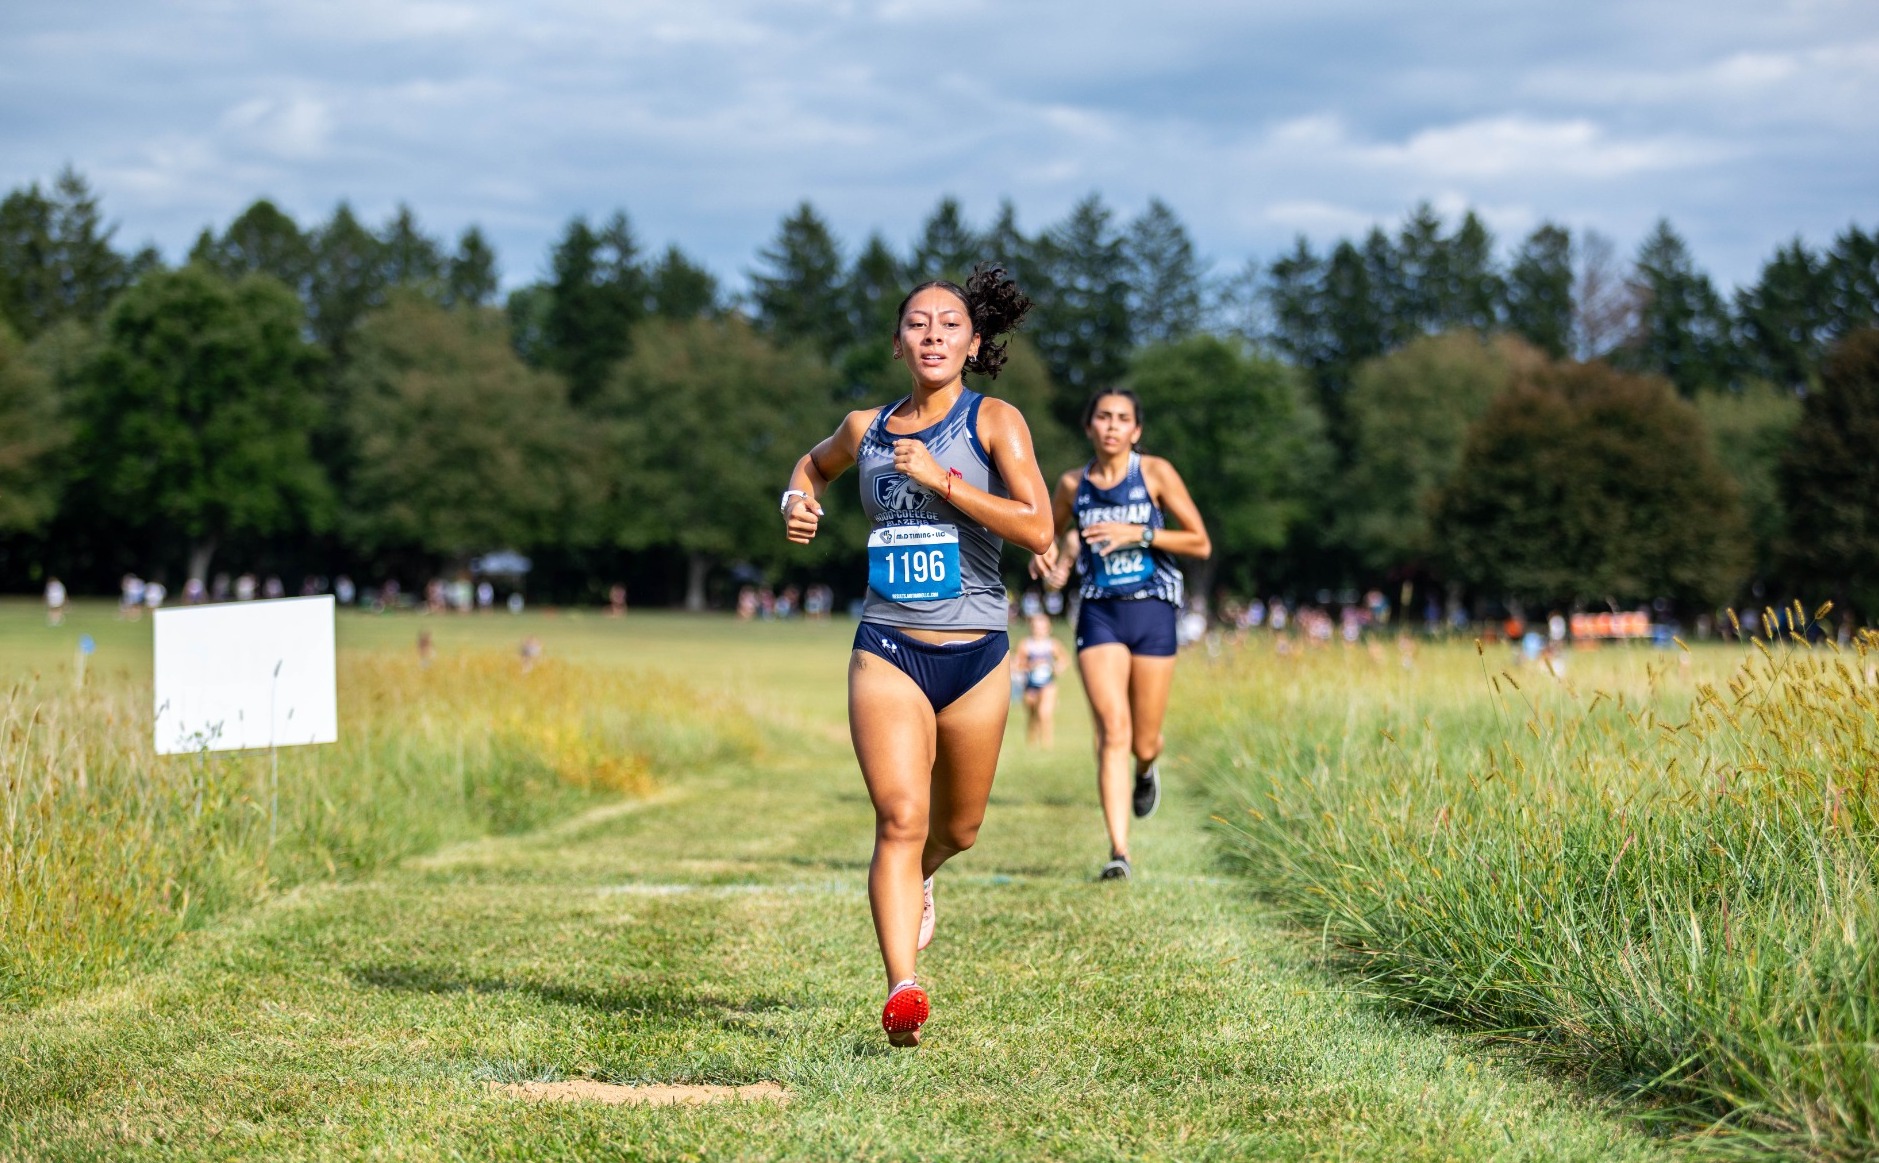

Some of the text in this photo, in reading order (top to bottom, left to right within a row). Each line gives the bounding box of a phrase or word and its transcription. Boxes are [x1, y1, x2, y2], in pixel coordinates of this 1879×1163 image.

[874, 509, 939, 522] HOOD COLLEGE
[886, 518, 929, 527] BLAZERS
[1079, 502, 1151, 528] MESSIAH
[885, 550, 946, 584] 1196
